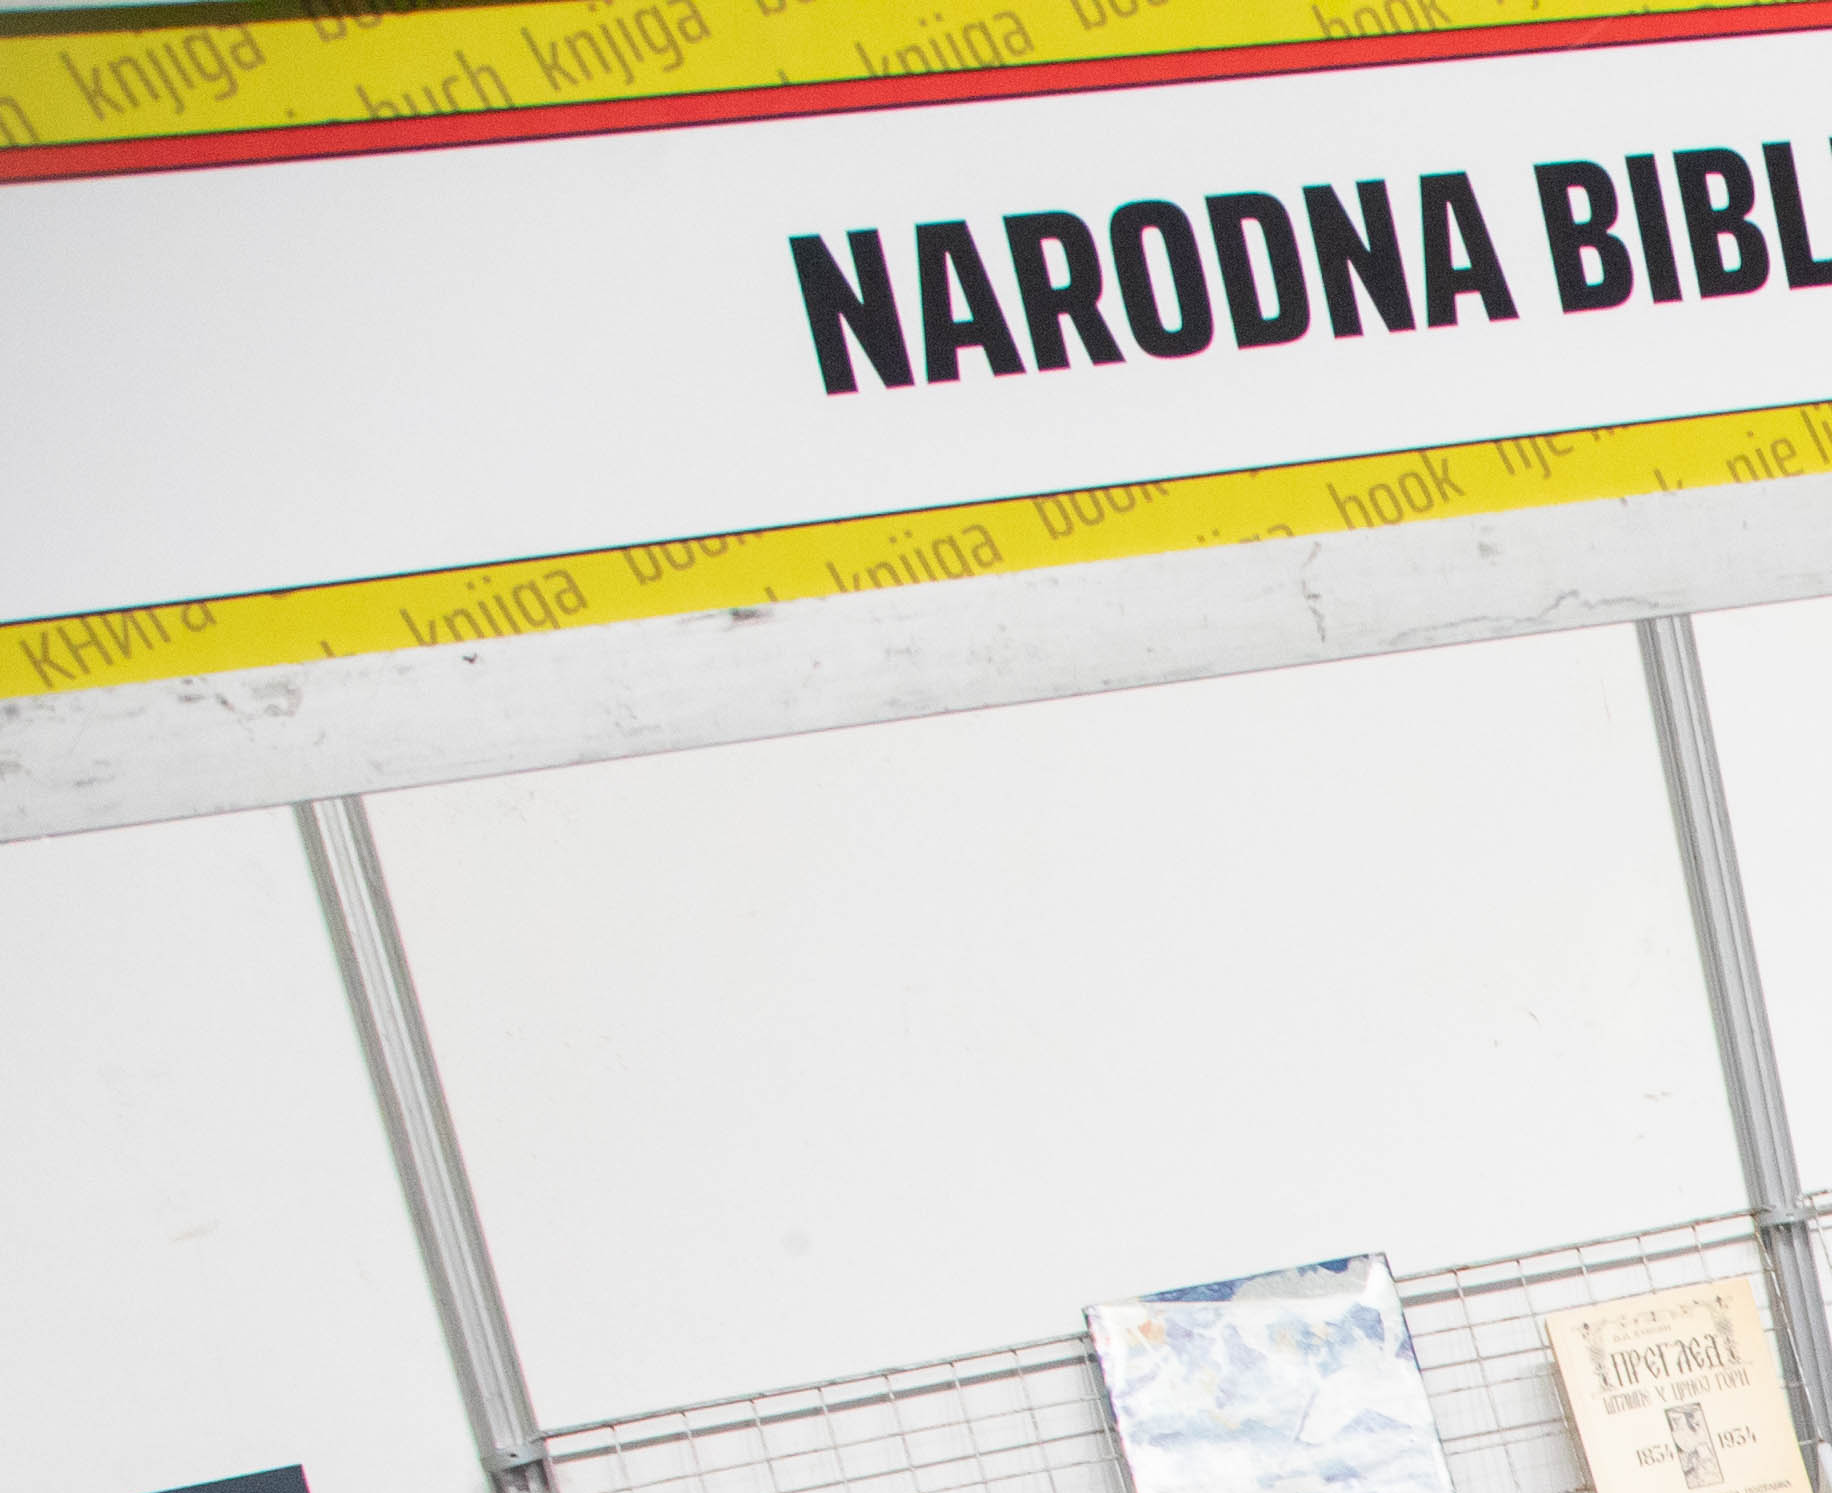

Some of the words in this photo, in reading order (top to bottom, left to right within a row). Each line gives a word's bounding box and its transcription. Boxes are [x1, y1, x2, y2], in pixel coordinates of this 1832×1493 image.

[58, 25, 266, 120] knjiga
[521, 0, 713, 92] knjiga
[790, 172, 1518, 394] NARODNA
[1610, 1333, 1729, 1388] ПРЕГЛЕД
